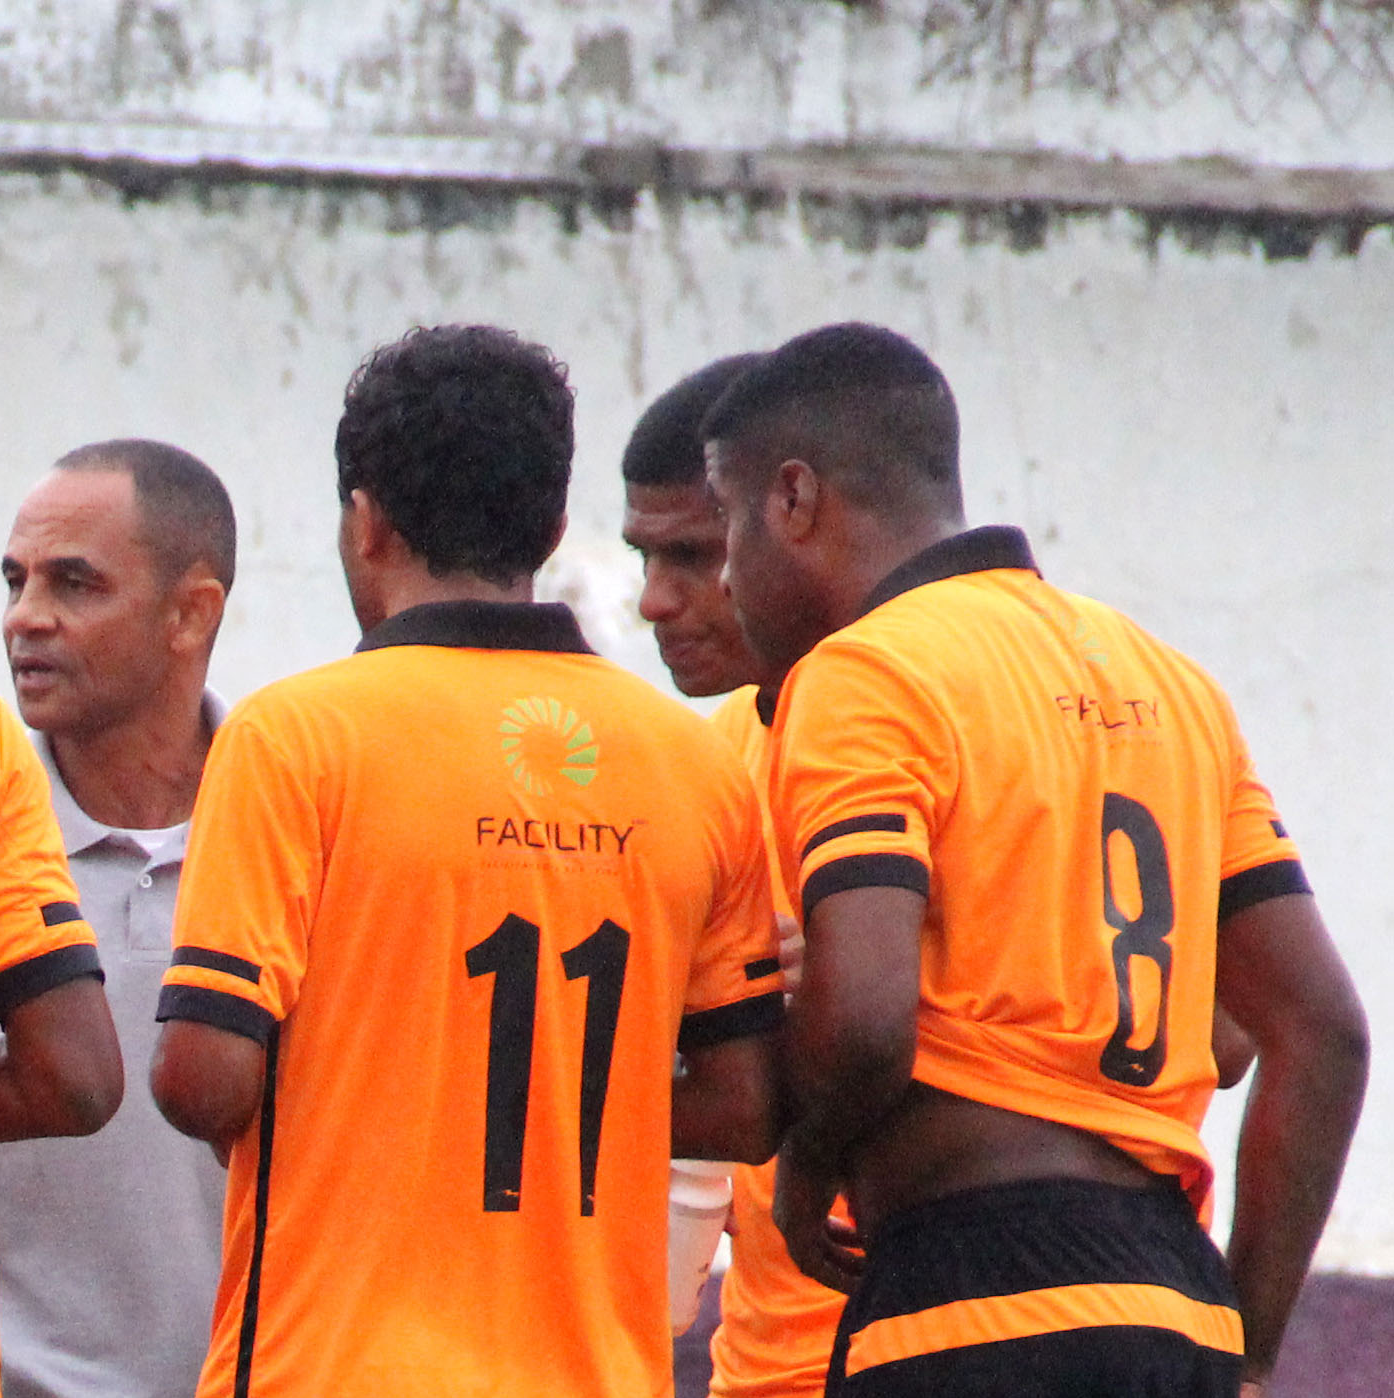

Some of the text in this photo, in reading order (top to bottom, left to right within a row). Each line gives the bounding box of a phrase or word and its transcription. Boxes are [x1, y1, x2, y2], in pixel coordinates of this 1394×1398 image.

[477, 817, 634, 854] FACILITY
[1100, 792, 1174, 1088] 8
[465, 912, 630, 1217] 11
